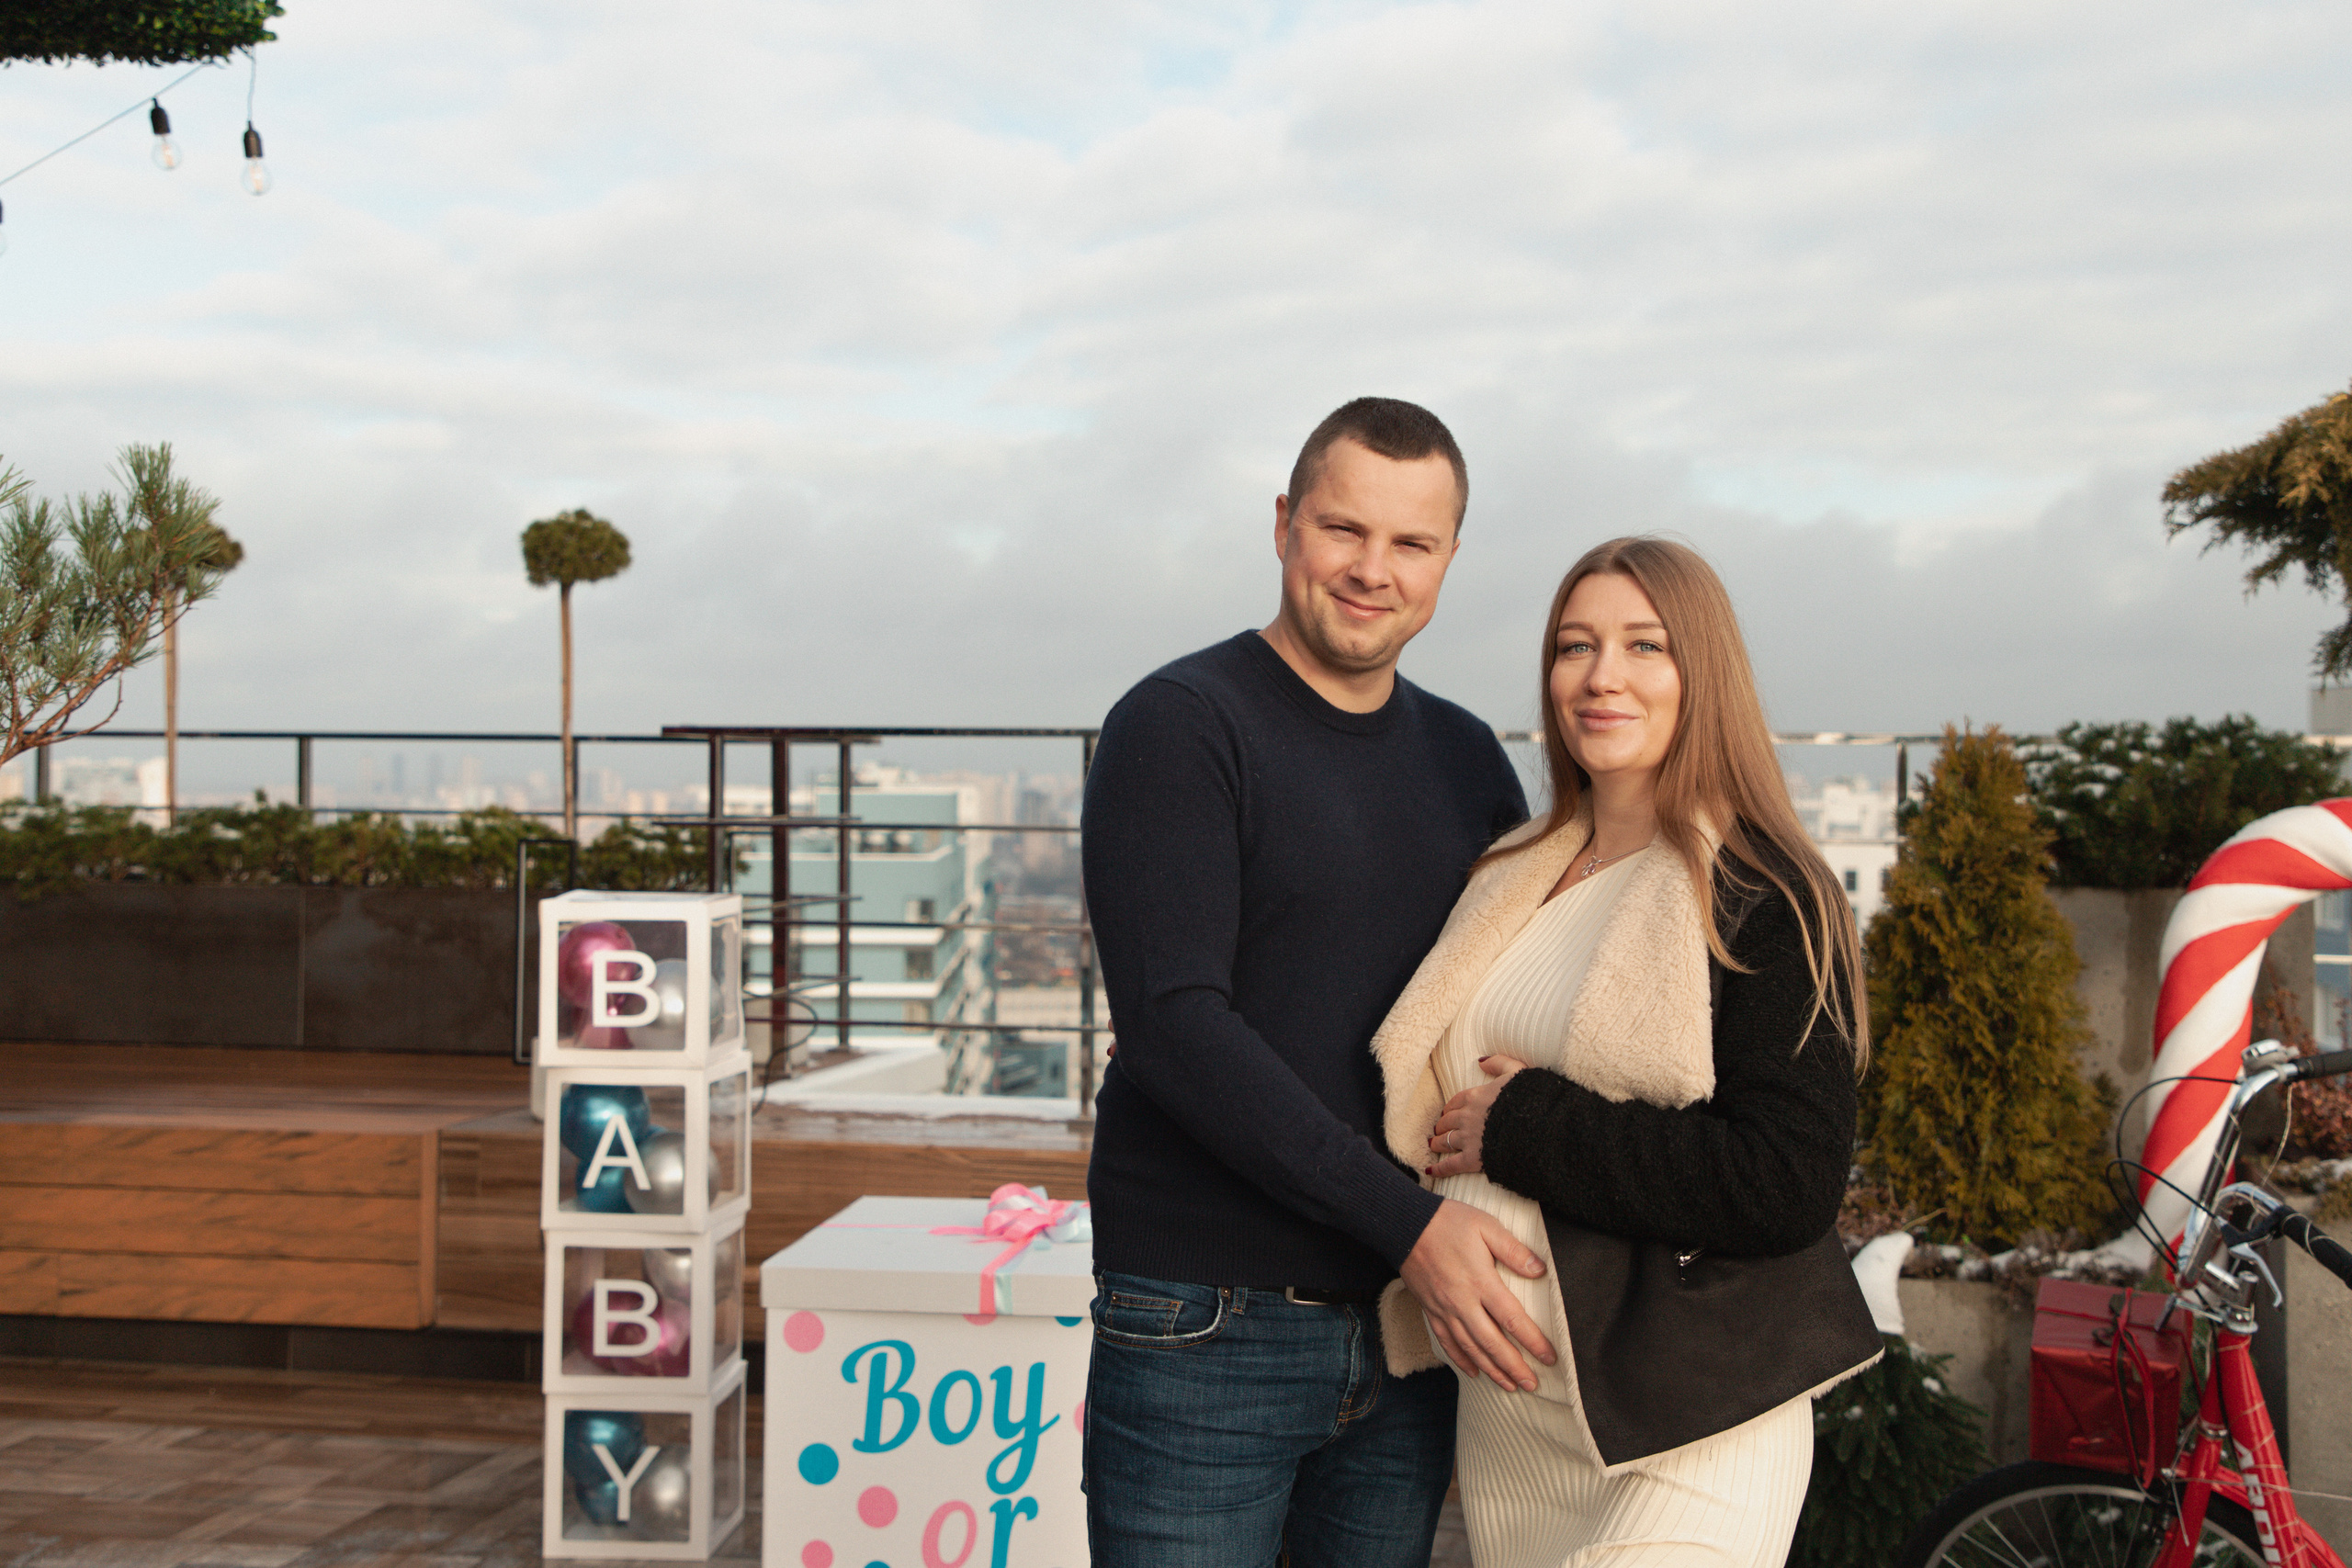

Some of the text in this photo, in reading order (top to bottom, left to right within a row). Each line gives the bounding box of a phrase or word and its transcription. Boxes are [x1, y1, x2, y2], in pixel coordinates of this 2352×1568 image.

[841, 1339, 1060, 1495] Boy
[922, 1496, 1039, 1568] or
[2232, 1437, 2283, 1568] ARDI
